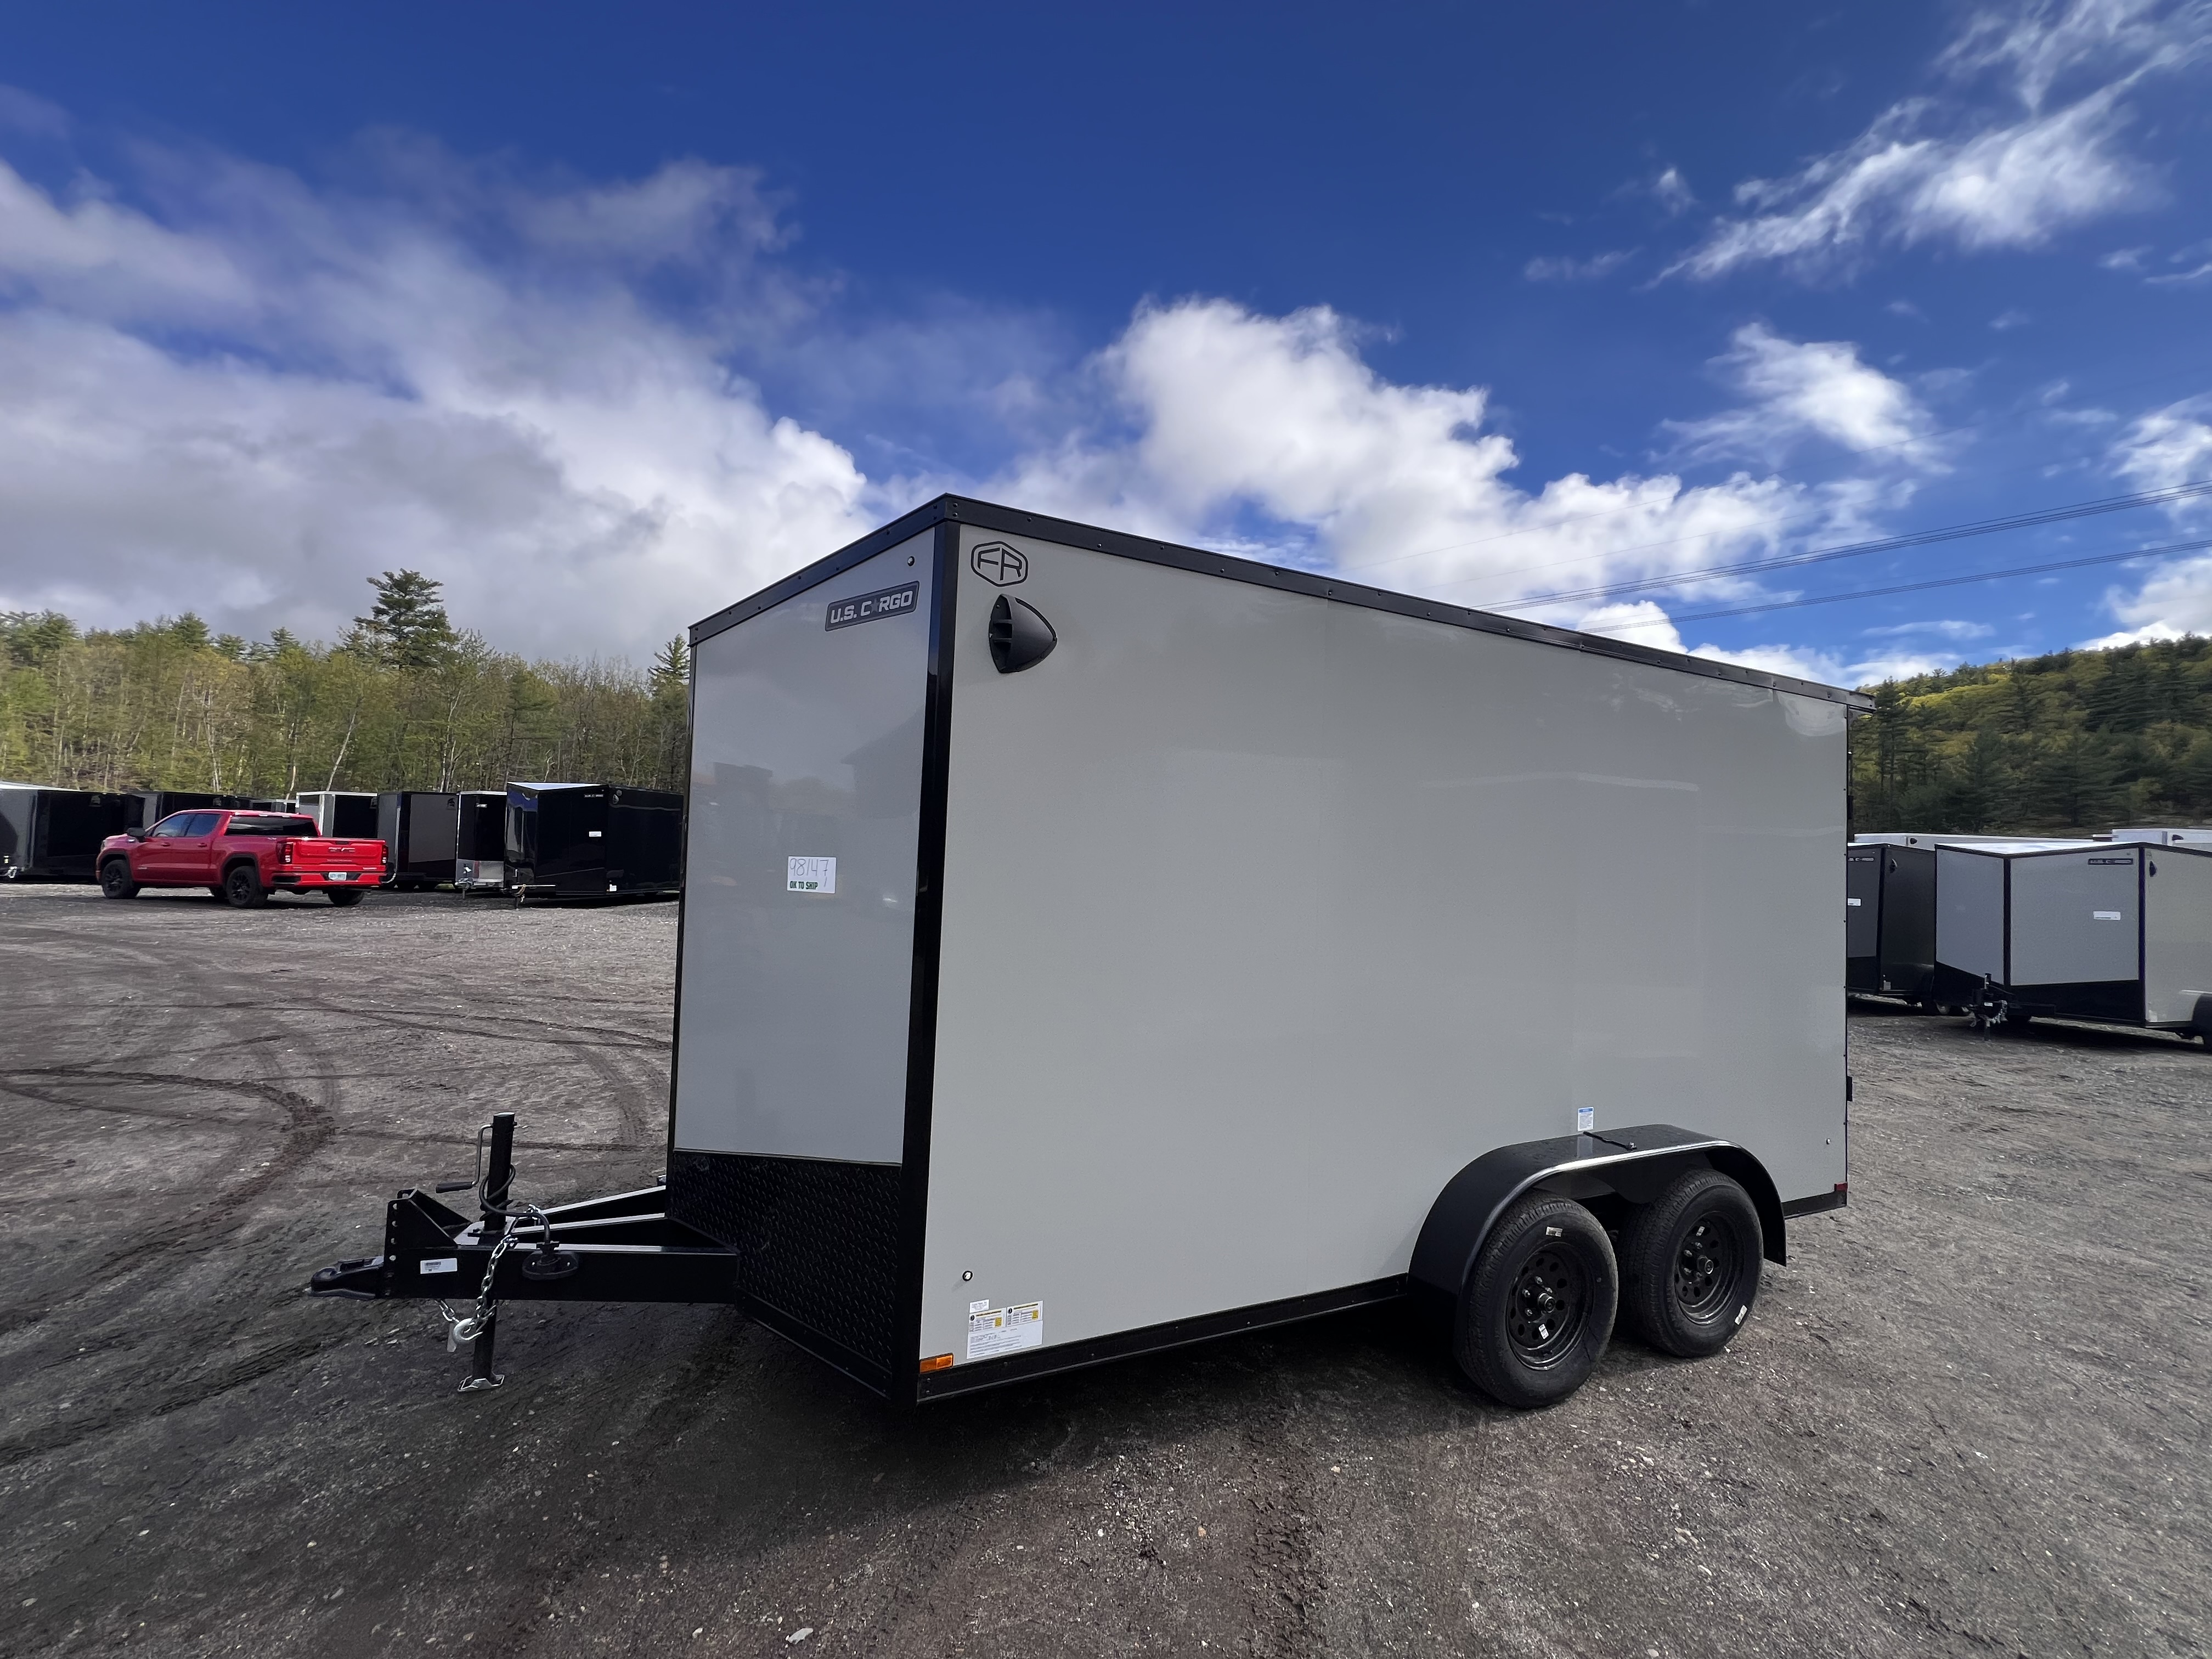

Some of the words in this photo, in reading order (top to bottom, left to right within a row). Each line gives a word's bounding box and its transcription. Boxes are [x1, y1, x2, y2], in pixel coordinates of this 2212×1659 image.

[831, 605, 857, 623] U.S.
[790, 858, 829, 876] 98147
[790, 881, 797, 889] OK
[798, 881, 804, 889] TO
